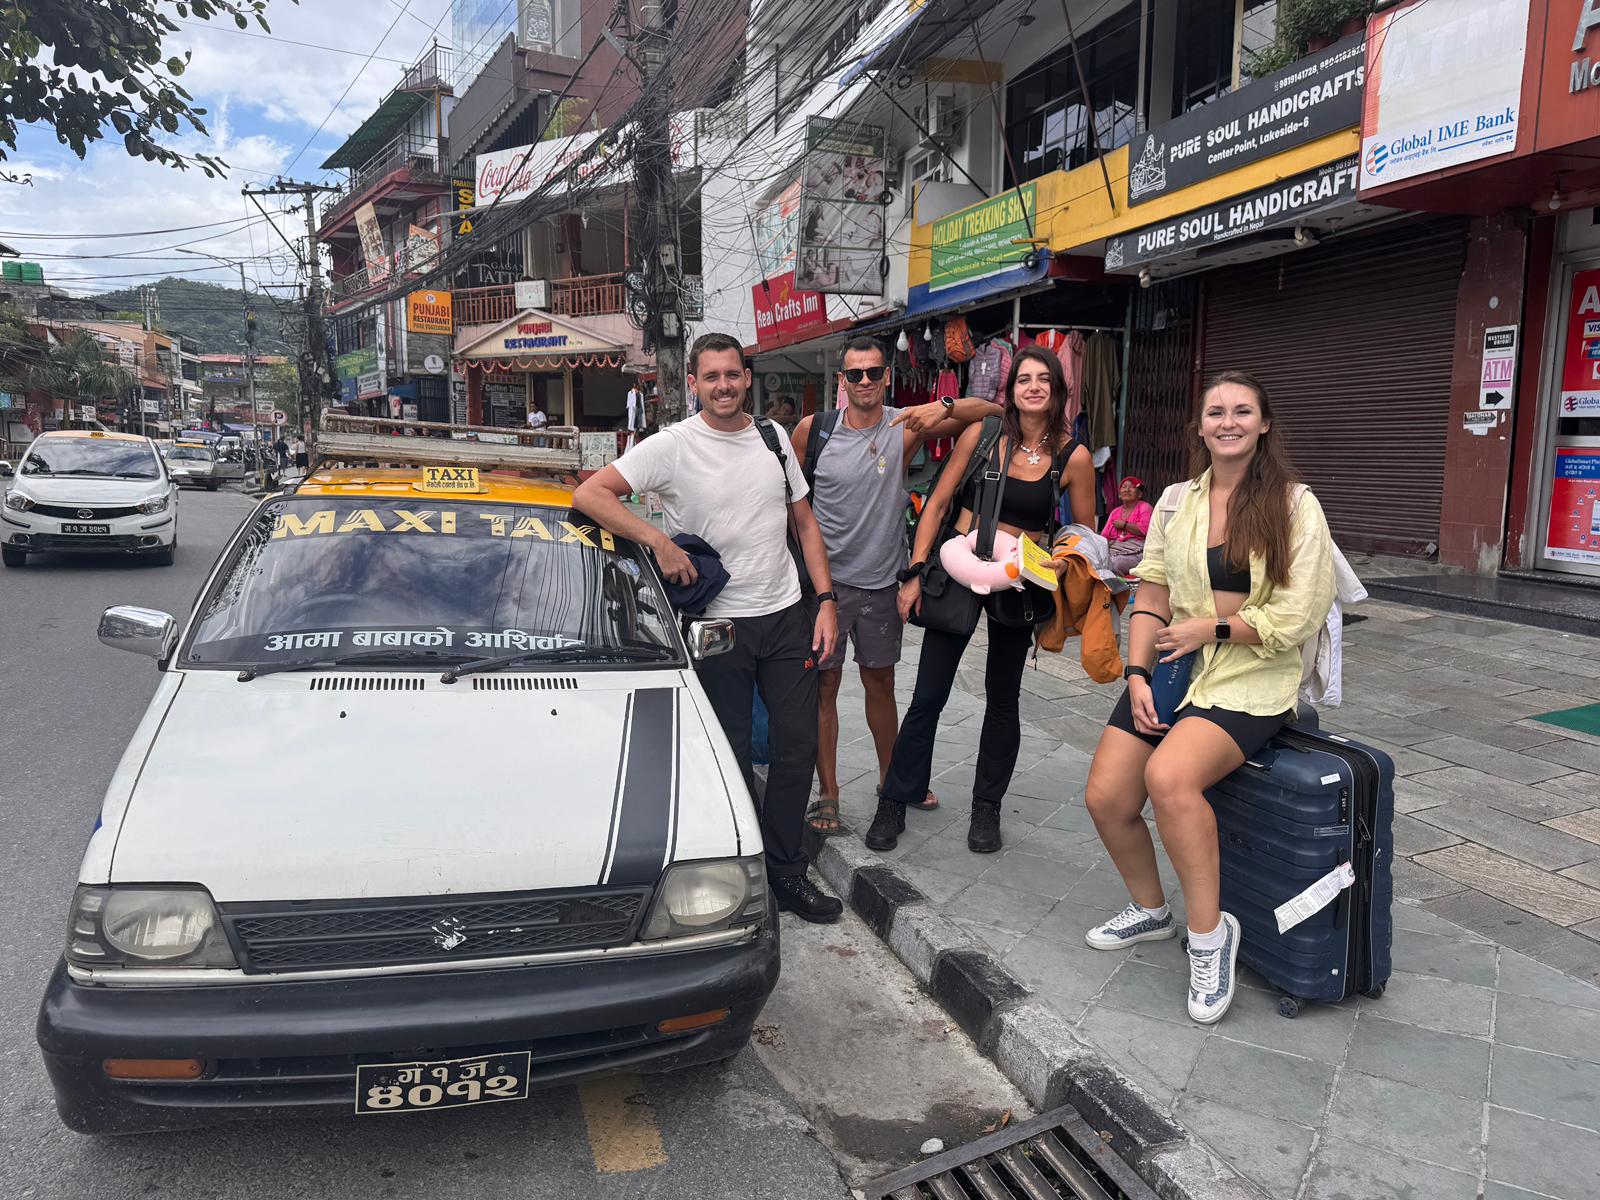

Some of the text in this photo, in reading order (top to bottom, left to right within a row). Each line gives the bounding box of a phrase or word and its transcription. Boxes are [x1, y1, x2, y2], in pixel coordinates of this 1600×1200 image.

[1170, 65, 1365, 163] PURE SOUL HANDICRAFTS
[1234, 138, 1258, 156] Point,
[1260, 116, 1309, 145] Lakeside-6
[1391, 107, 1515, 155] Global IME Bank
[1138, 166, 1359, 253] PURE SOUL HANDICRAFT
[933, 217, 964, 247] HOLIDAY
[964, 200, 1006, 238] TREKKING
[413, 303, 450, 317] PUNJABI
[413, 315, 450, 325] RESTAURANT
[757, 293, 818, 328] Real Crafts Inn
[518, 322, 552, 335] PUNJABI
[504, 336, 568, 349] RESTAURANT
[1483, 360, 1513, 380] ATM
[273, 412, 284, 424] P
[427, 468, 475, 481] TAXI
[272, 509, 615, 552] MAXI TAXI
[264, 631, 343, 651] आमा
[352, 626, 456, 648] बाबाको
[431, 1067, 448, 1084] १
[459, 1061, 489, 1080] ज
[366, 1075, 519, 1109] ४०१२
